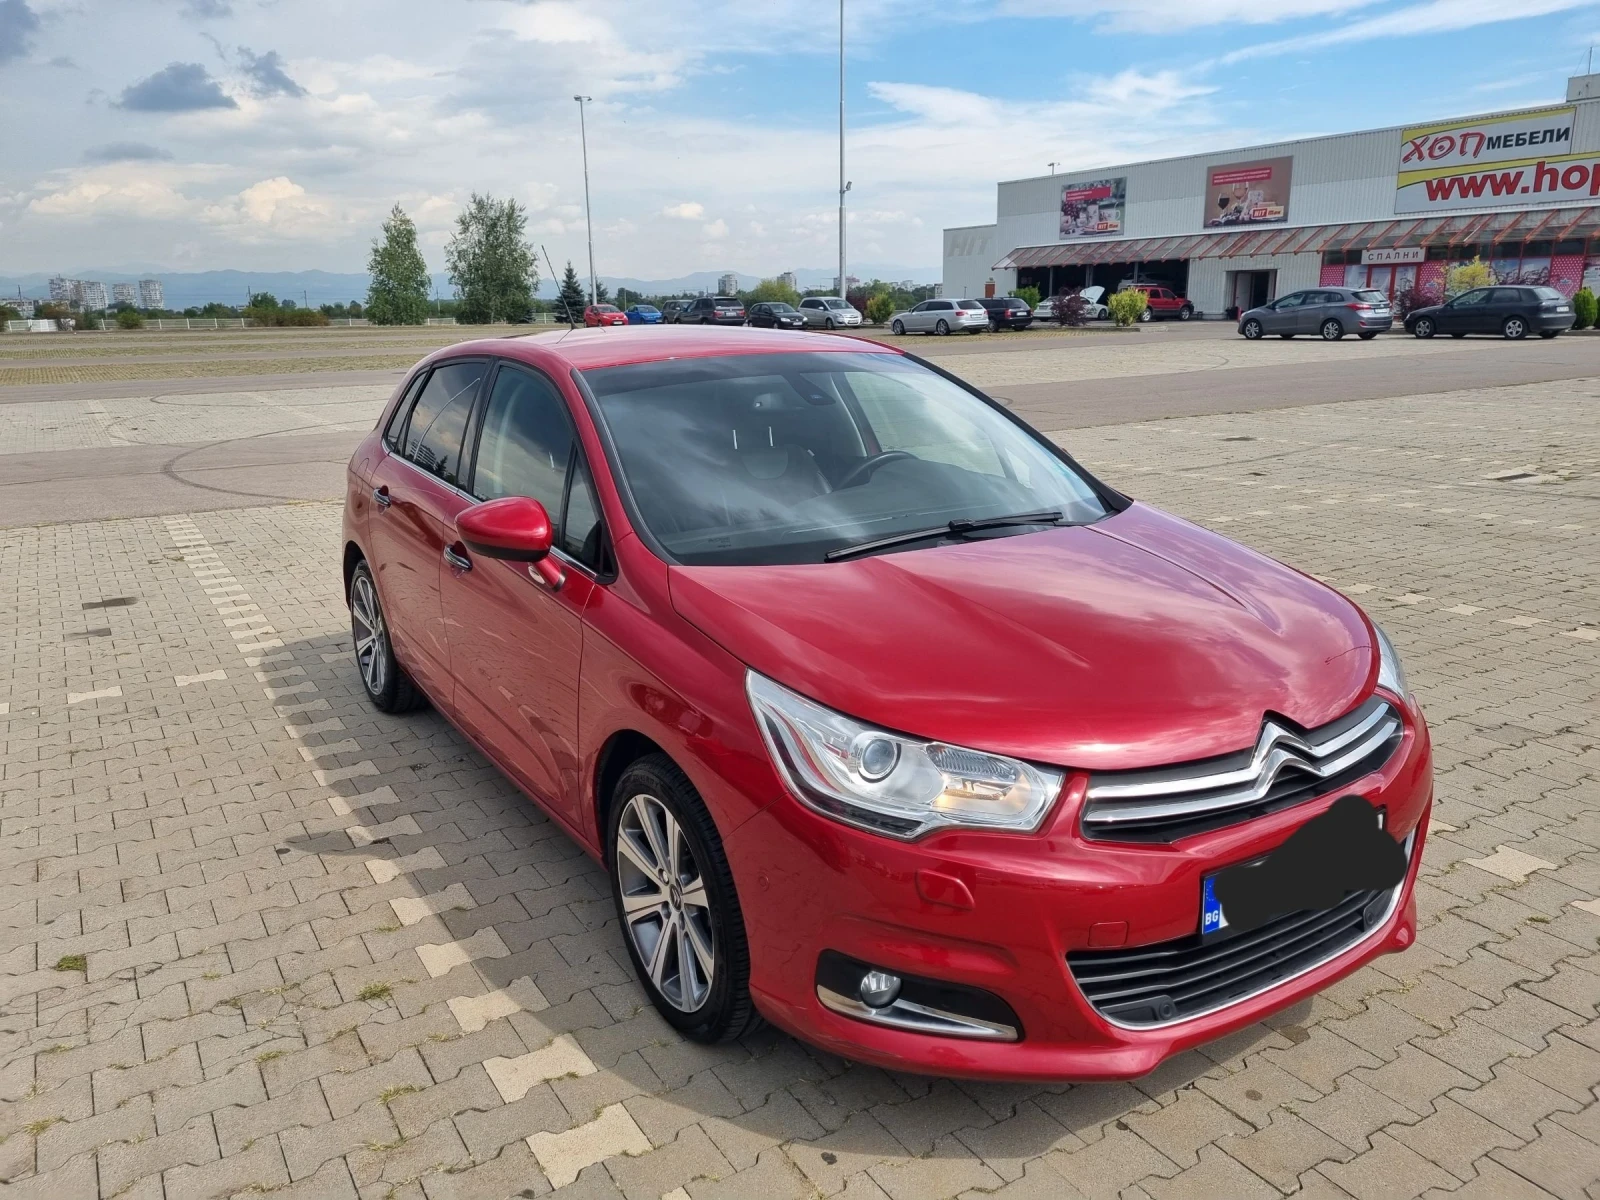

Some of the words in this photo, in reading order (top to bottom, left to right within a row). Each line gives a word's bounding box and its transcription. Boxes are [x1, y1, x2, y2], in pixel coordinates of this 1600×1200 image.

[1402, 130, 1487, 164] ХОП
[1486, 127, 1571, 150] МЕБЕЛИ
[1368, 251, 1419, 261] СПАЛНИ
[1205, 910, 1219, 925] BG
